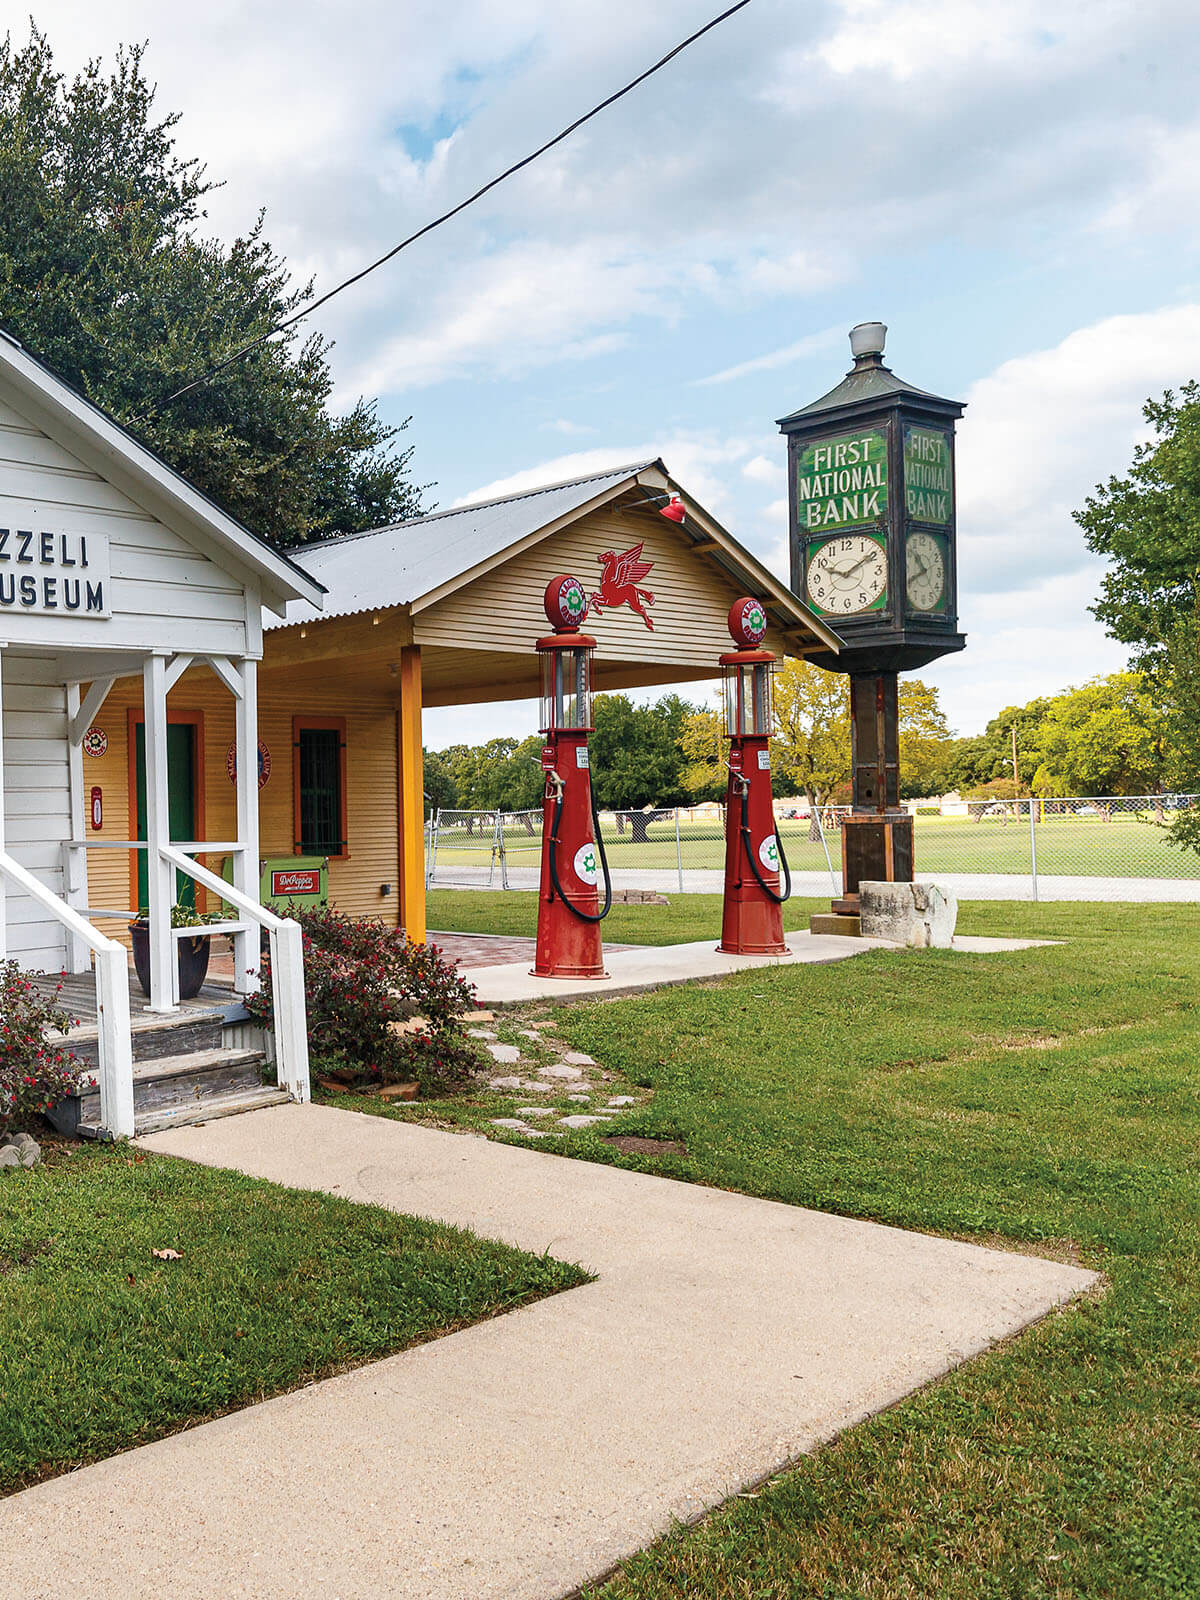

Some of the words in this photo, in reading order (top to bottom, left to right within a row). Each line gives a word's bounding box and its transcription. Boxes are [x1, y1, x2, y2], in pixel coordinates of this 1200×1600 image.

[911, 435, 942, 463] FIRST
[814, 438, 873, 472] FIRST
[800, 463, 886, 500] NATIONAL
[904, 460, 949, 492] NATIONAL
[807, 490, 881, 528] BANK
[907, 490, 947, 521] BANK
[841, 540, 853, 551] 12
[861, 542, 864, 552] 1
[828, 546, 836, 557] 11
[869, 551, 877, 561] 2
[817, 558, 828, 568] 10
[874, 565, 883, 576] 3
[813, 574, 821, 584] 9
[870, 580, 879, 591] 4
[817, 587, 825, 597] 8
[858, 592, 867, 603] 5
[829, 597, 836, 607] 7
[843, 598, 851, 608] 6
